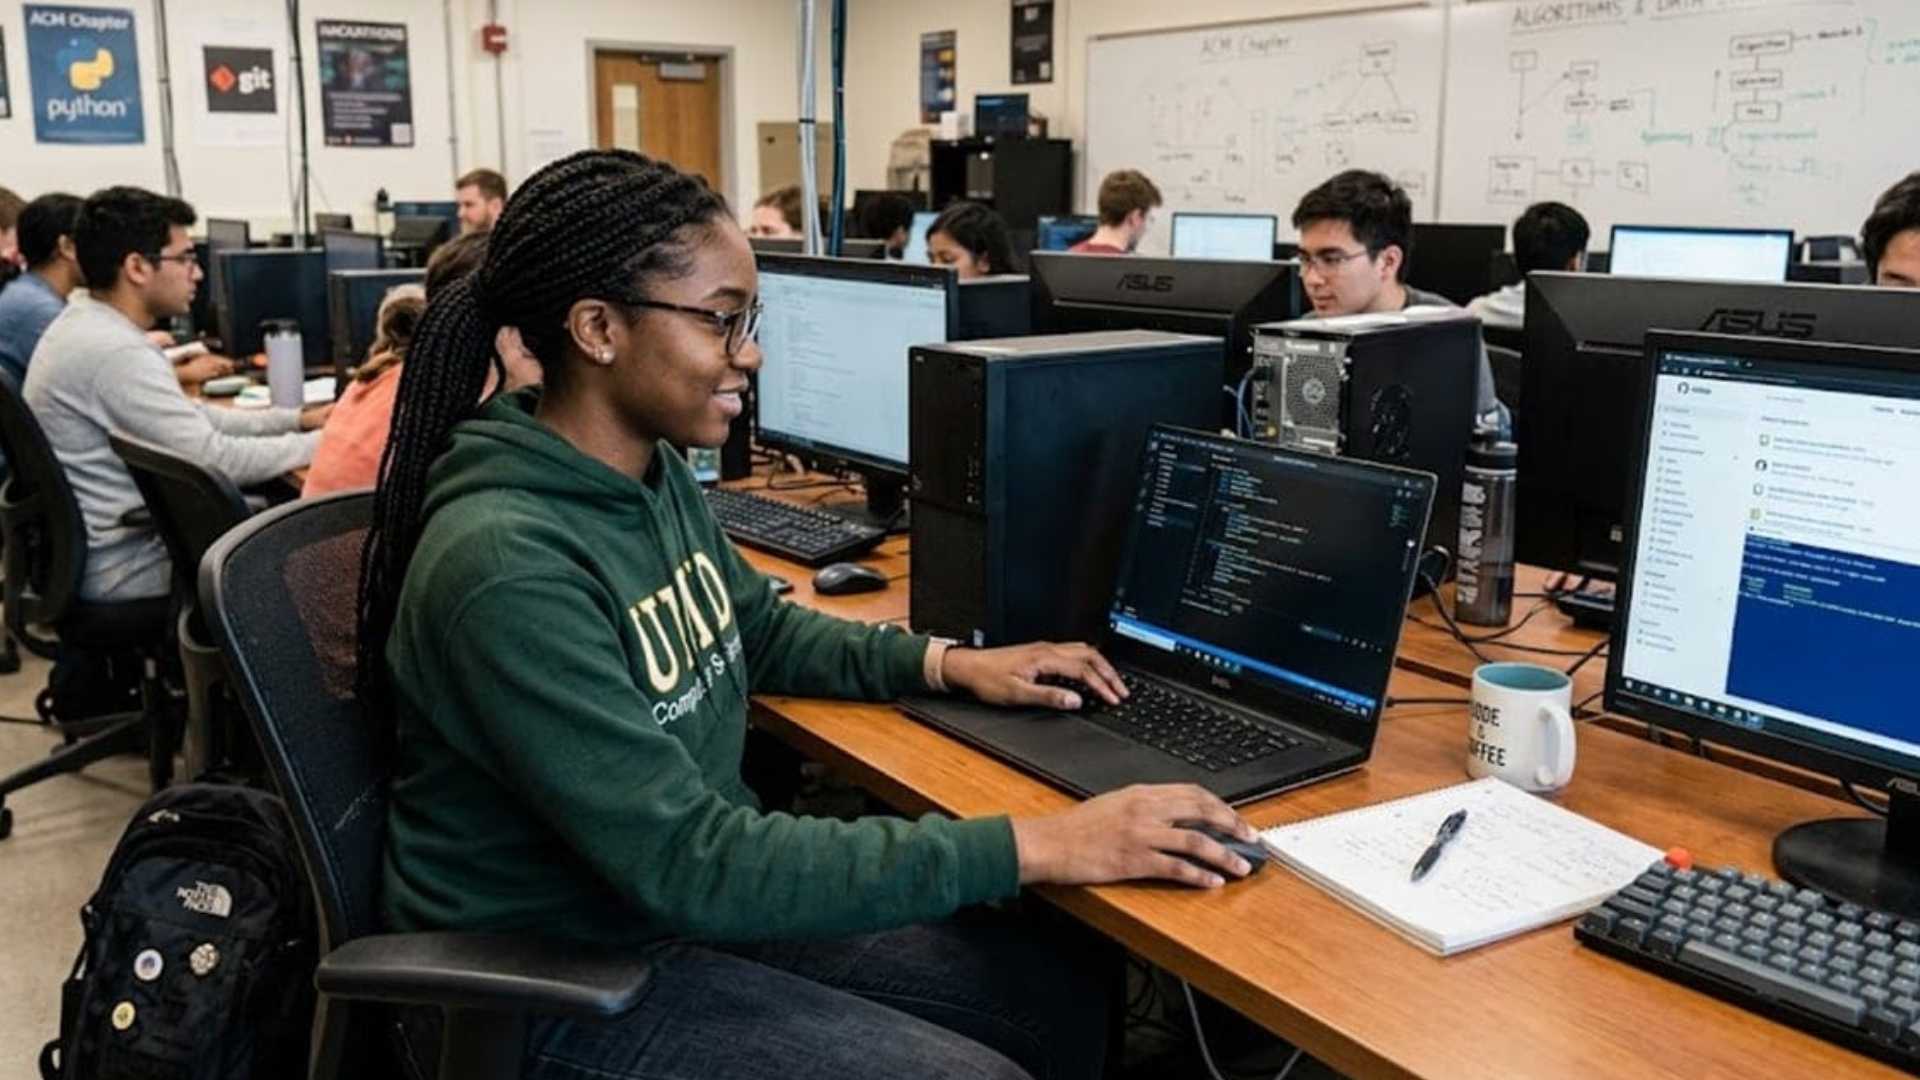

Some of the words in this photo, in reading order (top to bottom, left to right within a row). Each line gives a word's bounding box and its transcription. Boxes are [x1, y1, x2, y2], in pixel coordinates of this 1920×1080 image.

[29, 10, 66, 27] ACM
[69, 12, 129, 33] Chapter
[239, 66, 272, 94] git
[47, 93, 127, 122] python
[1116, 273, 1176, 293] ASUS
[1701, 308, 1817, 338] ASUS
